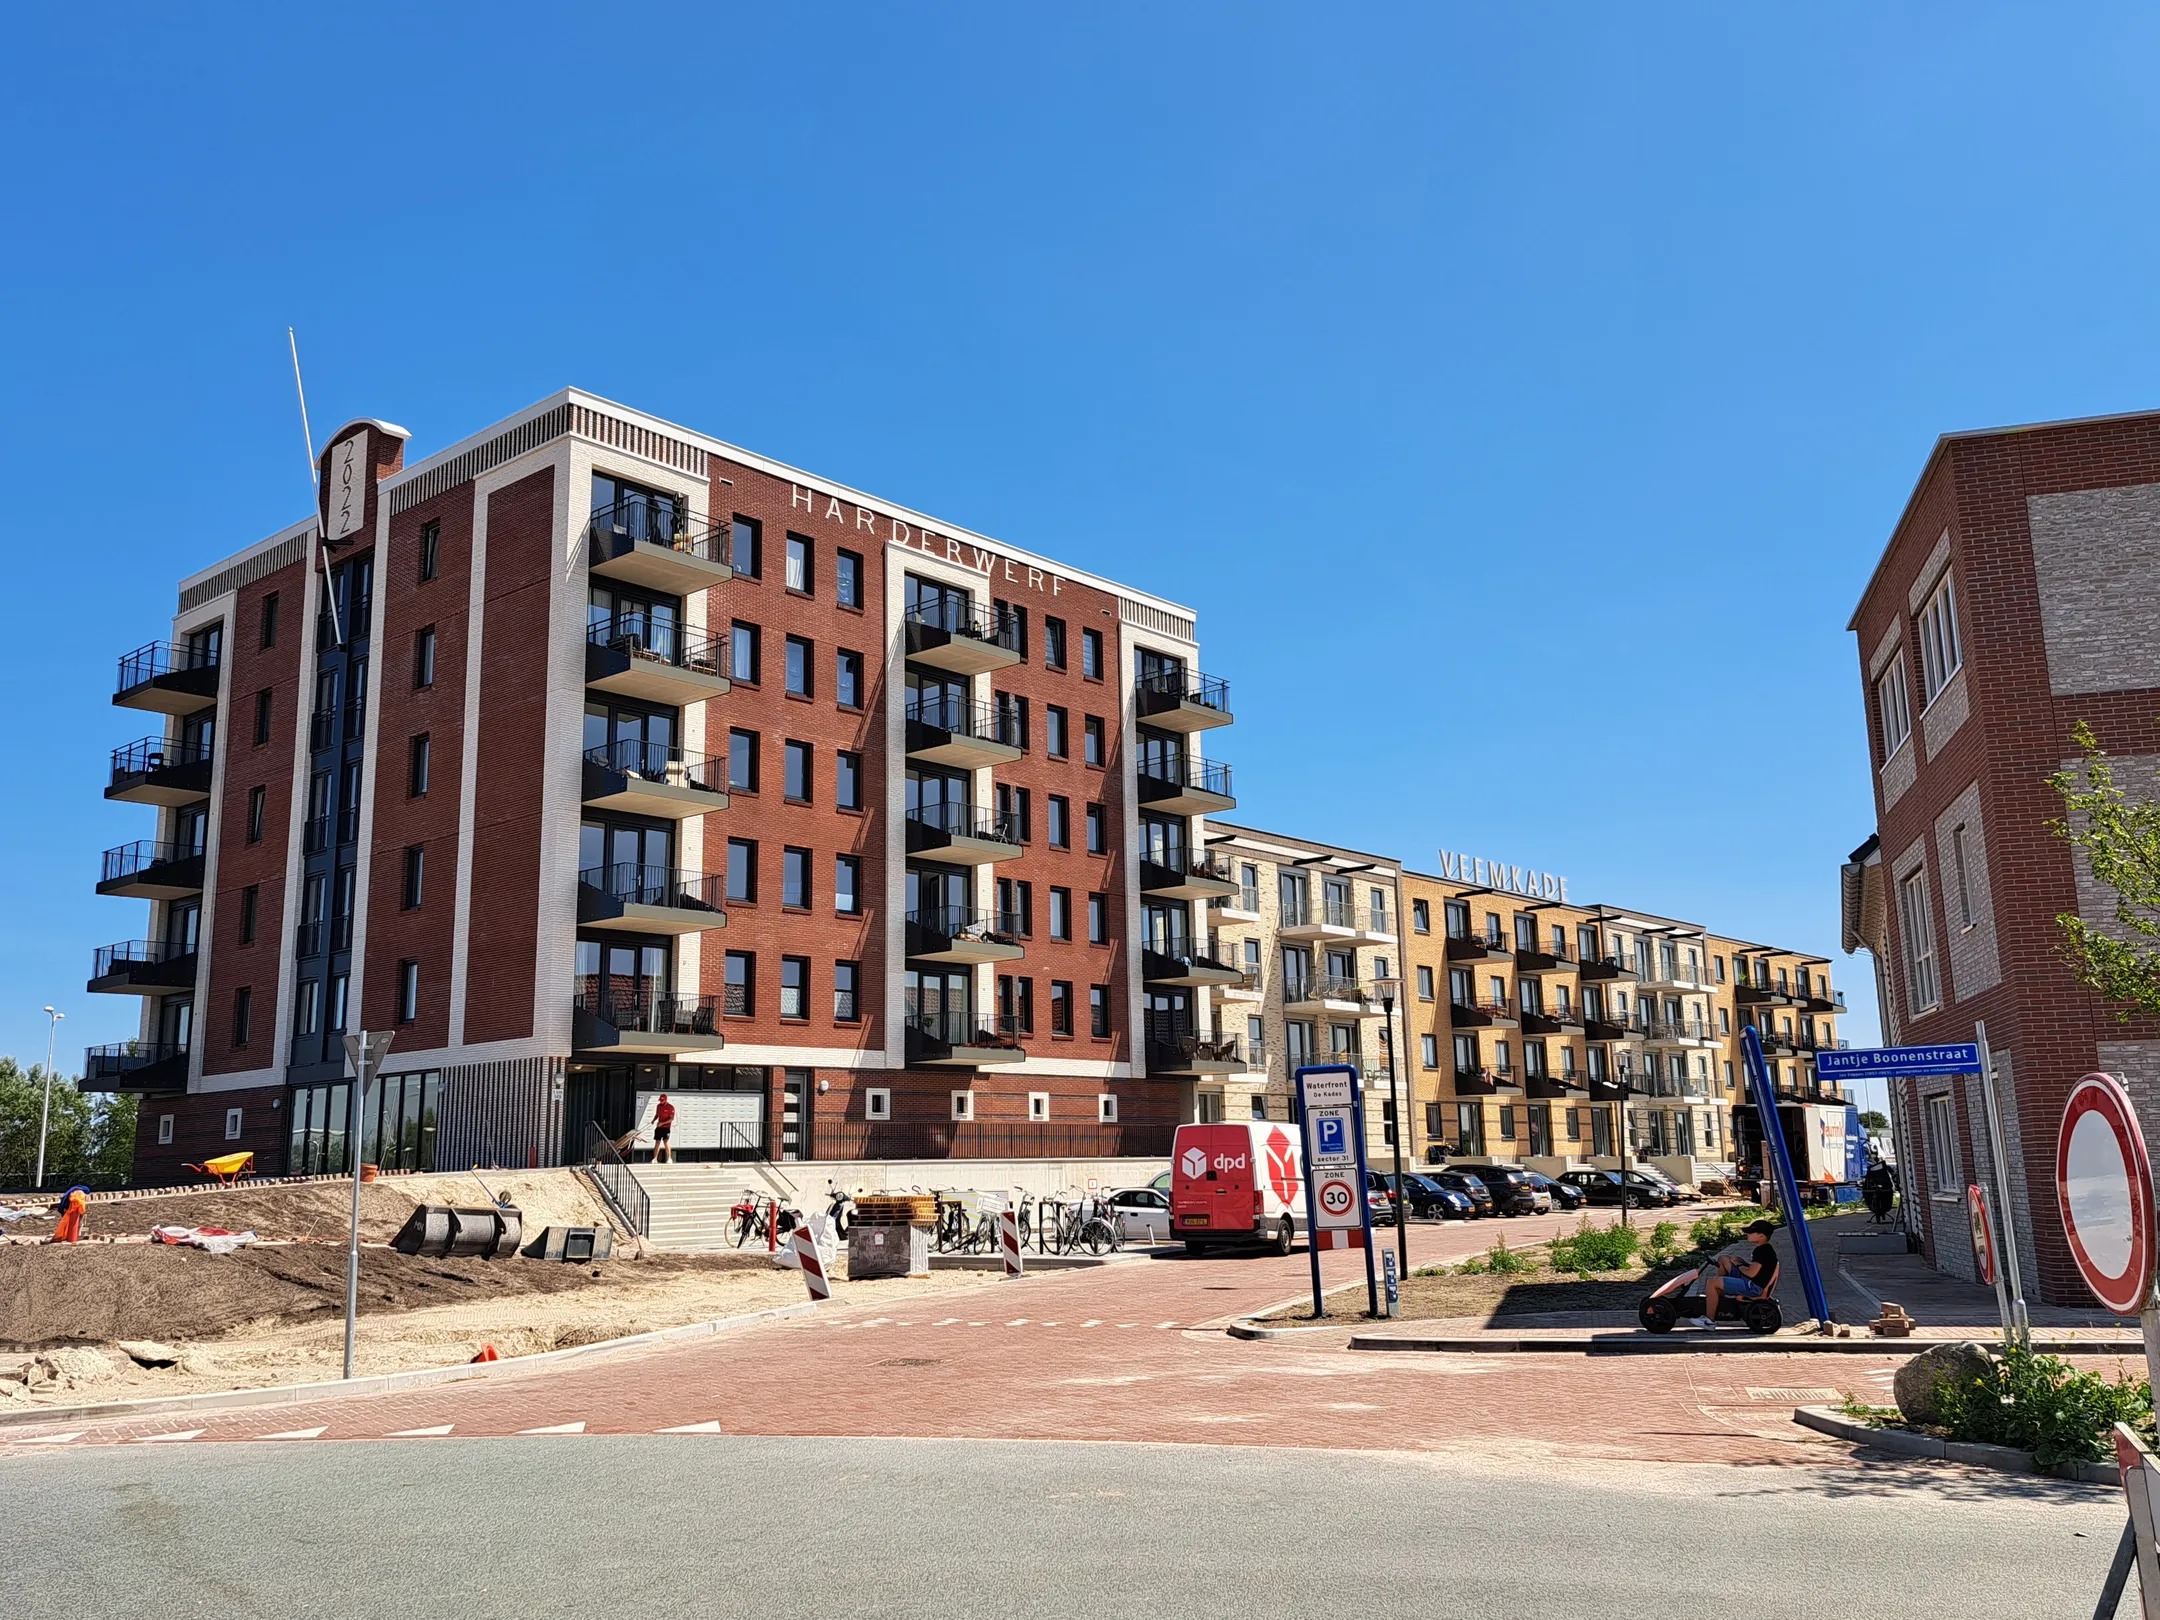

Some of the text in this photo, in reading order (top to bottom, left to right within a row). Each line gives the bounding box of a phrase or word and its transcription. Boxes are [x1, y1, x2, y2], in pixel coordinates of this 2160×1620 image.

[340, 439, 354, 534] 2022
[792, 484, 1066, 596] HARDERWERF
[1438, 849, 1568, 902] VEEMKADE
[1828, 1049, 1968, 1067] Jantje Boonenstraat
[1306, 1081, 1348, 1090] Waterfront
[1322, 1121, 1338, 1142] P
[1213, 1153, 1246, 1173] dpd
[1326, 1191, 1348, 1205] 30
